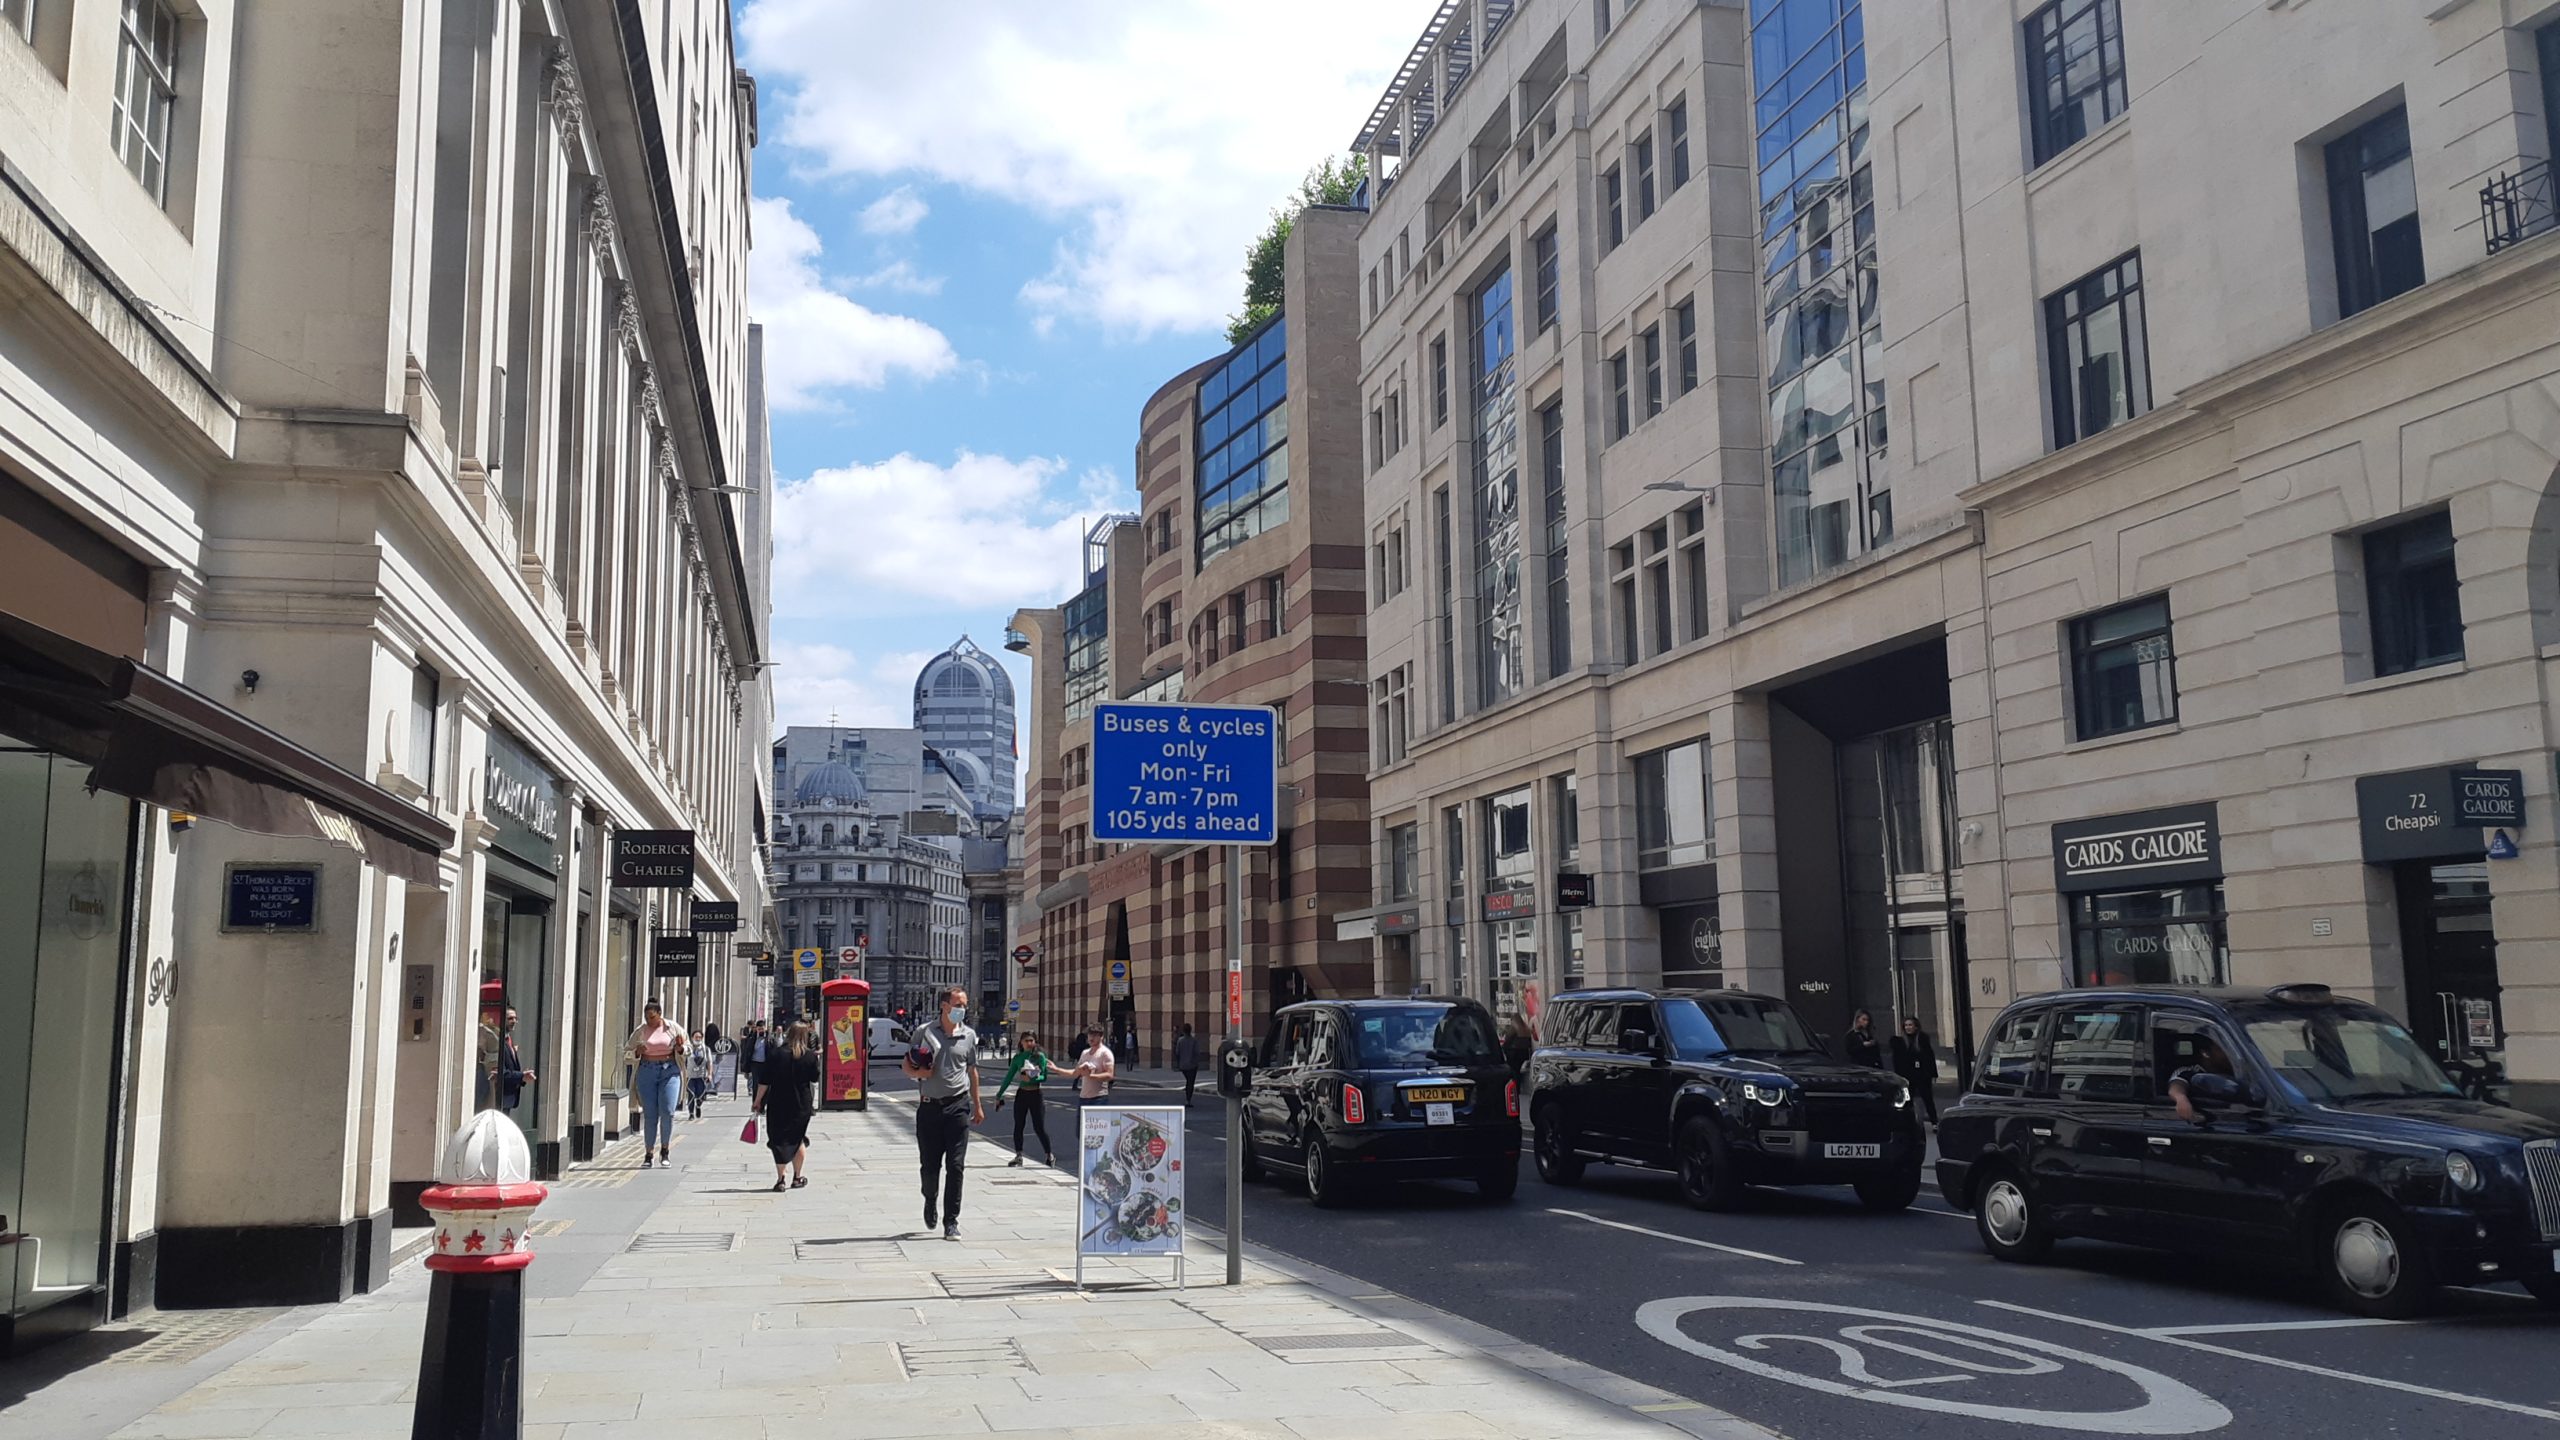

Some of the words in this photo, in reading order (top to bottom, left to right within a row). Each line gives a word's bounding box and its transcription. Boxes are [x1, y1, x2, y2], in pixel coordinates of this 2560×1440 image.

[1103, 713, 1169, 733] Buses
[1178, 715, 1192, 734] &
[1200, 718, 1265, 738] cycles
[1162, 740, 1207, 761] only
[2464, 783, 2510, 797] CARDS
[2409, 793, 2427, 810] 72
[2463, 800, 2516, 814] GALORE
[1195, 812, 1260, 831] ahead
[620, 841, 690, 855] RODERICK
[2065, 840, 2124, 868] CARDS
[2131, 829, 2208, 860] GALORE
[621, 861, 684, 876] CHARLES
[245, 876, 275, 885] THOMAS
[284, 876, 312, 886] BECKET
[261, 902, 282, 910] NEAR
[1487, 894, 1513, 912] TESCO
[1513, 892, 1534, 907] Metro
[250, 910, 269, 918] THIS
[692, 912, 713, 920] MOSS
[2114, 936, 2158, 954] CARDS
[2163, 934, 2213, 952] GALOR
[148, 956, 178, 1008] 90
[1800, 981, 1831, 993] eighty
[1982, 976, 1996, 995] 80
[1232, 1000, 1241, 1019] gum
[1412, 1089, 1438, 1100] LN20
[1441, 1088, 1459, 1099] WGY
[1830, 1146, 1853, 1156] LG21
[1856, 1146, 1875, 1156] XTU
[1734, 1323, 2065, 1389] 20
